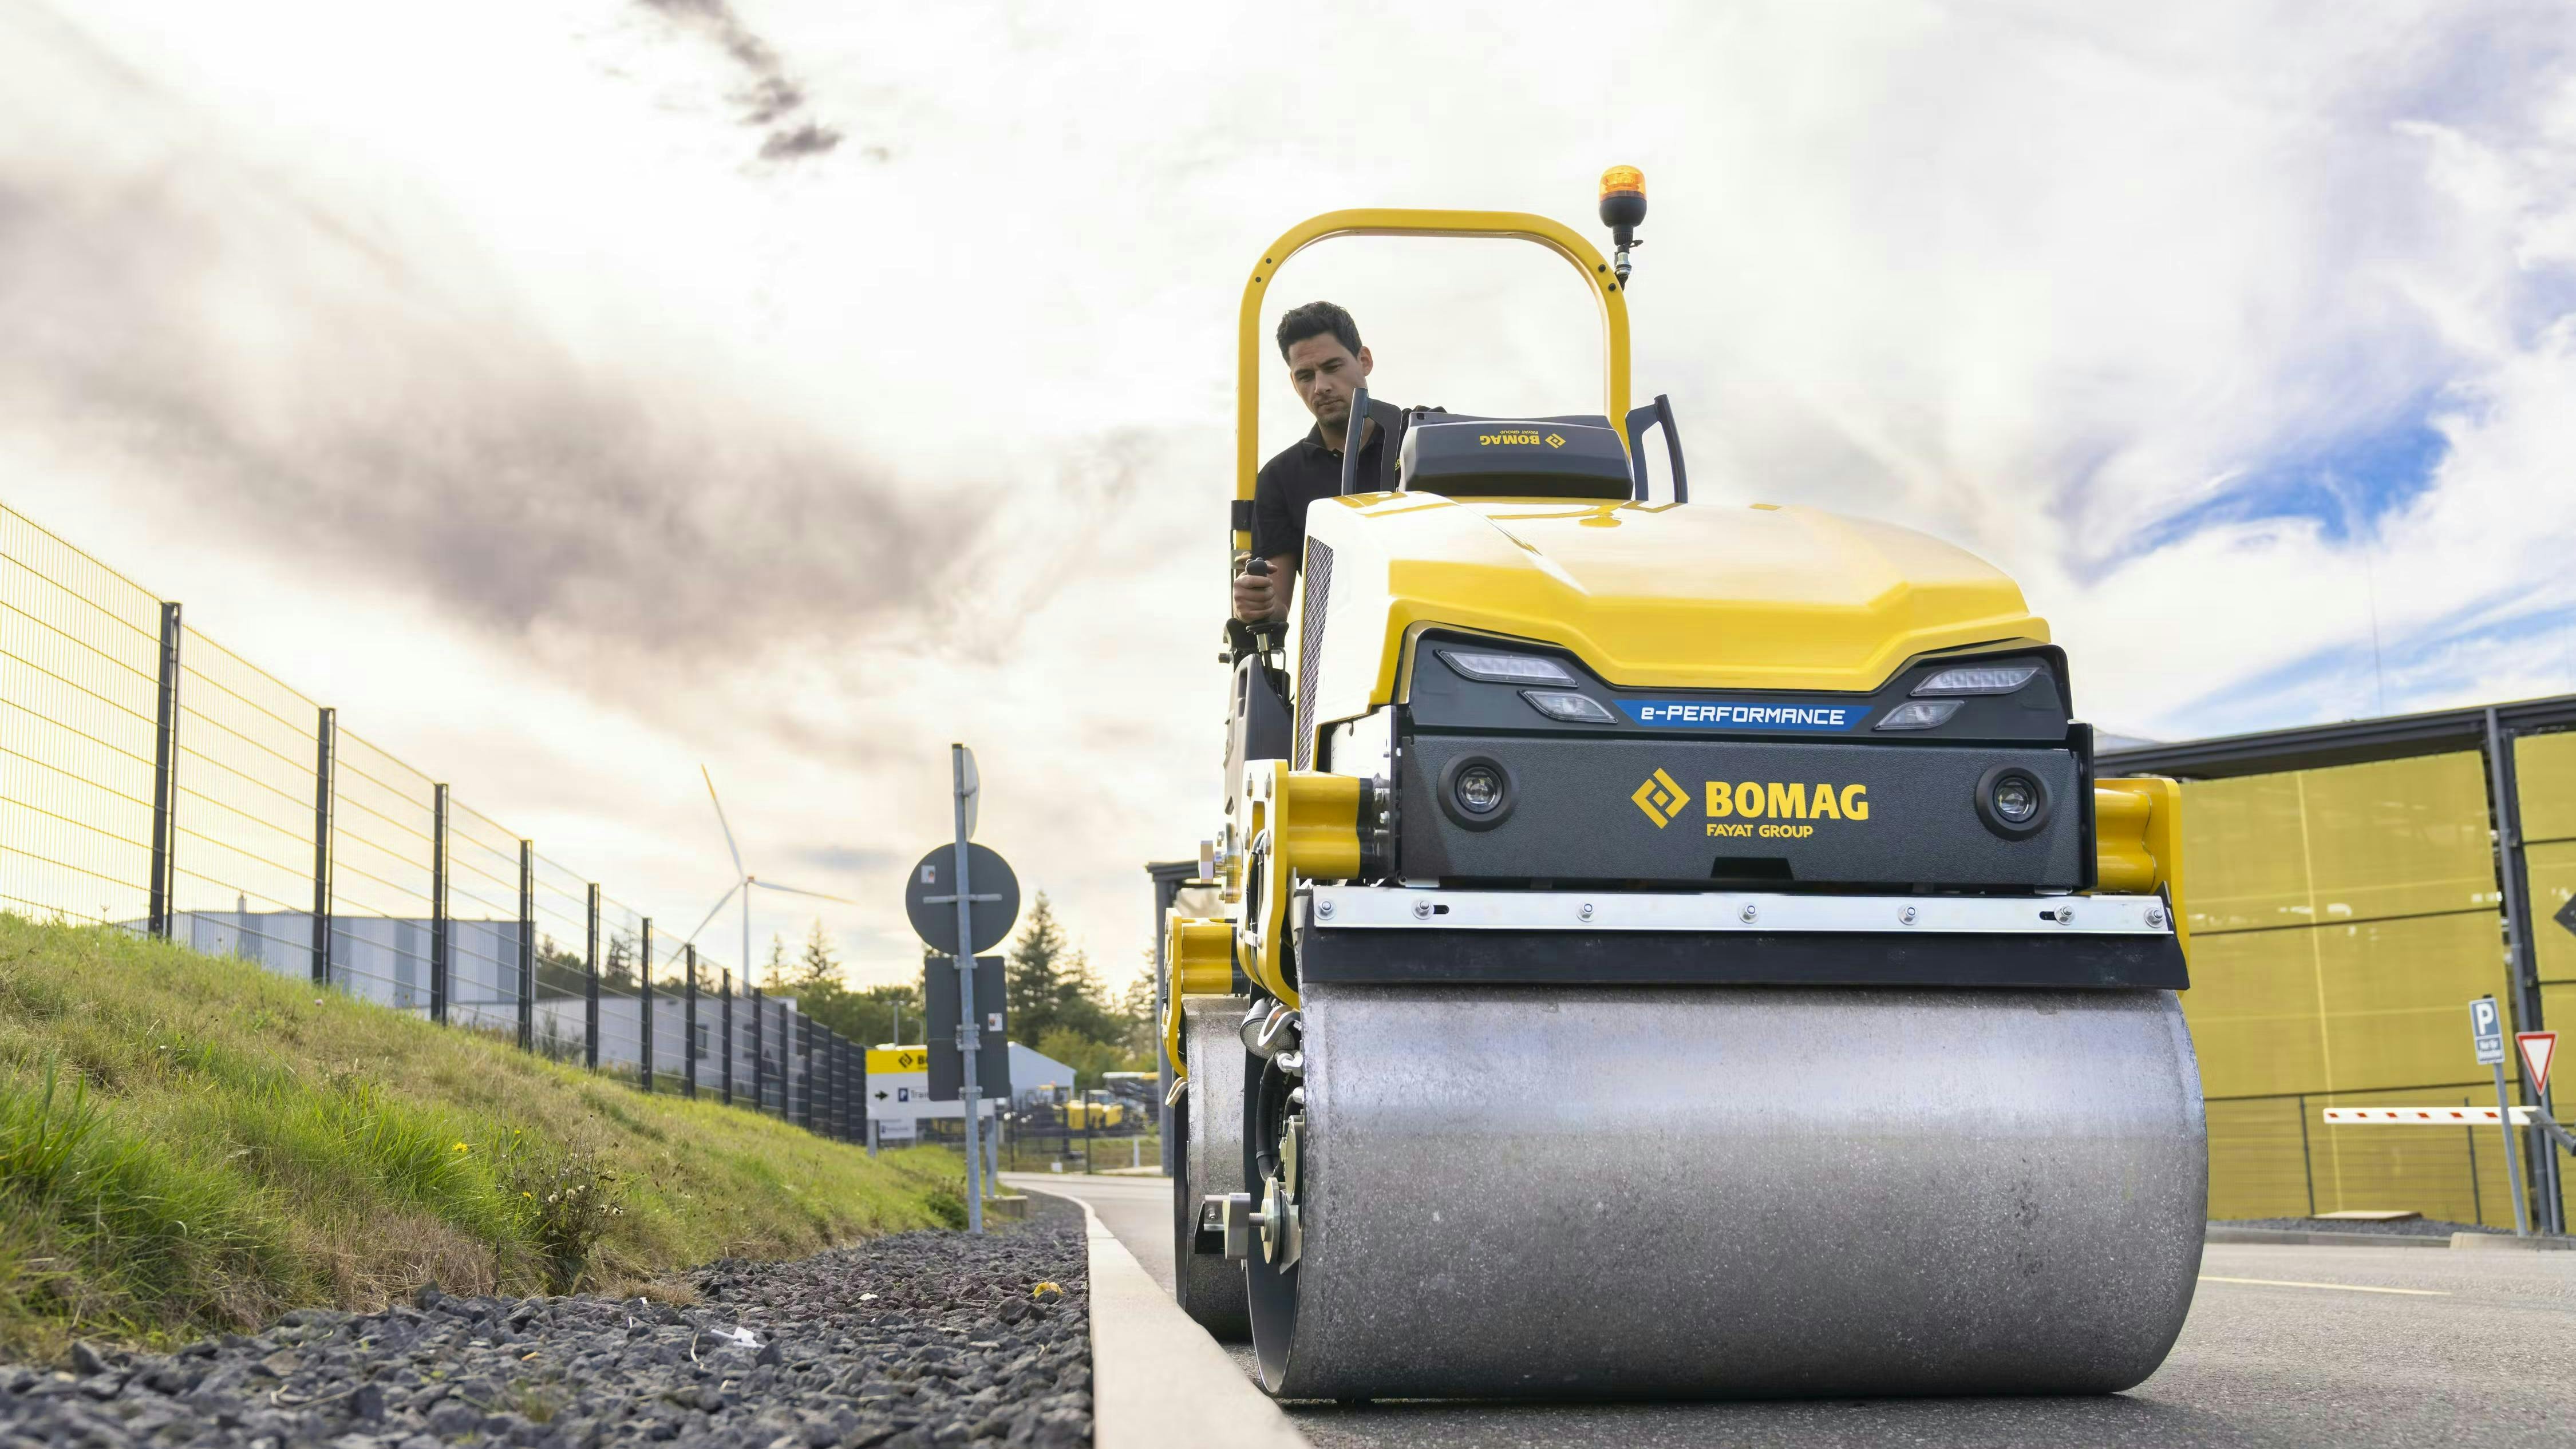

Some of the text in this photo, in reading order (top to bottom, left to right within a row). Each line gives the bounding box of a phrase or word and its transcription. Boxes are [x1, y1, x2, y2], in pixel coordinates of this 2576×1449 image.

[1479, 434, 1540, 445] BOMAG
[1641, 705, 1846, 725] e-PERFORMANCE
[1705, 781, 1869, 821] BOMAG
[1706, 824, 1814, 838] FAYAT GROUP
[2475, 1003, 2495, 1035] P
